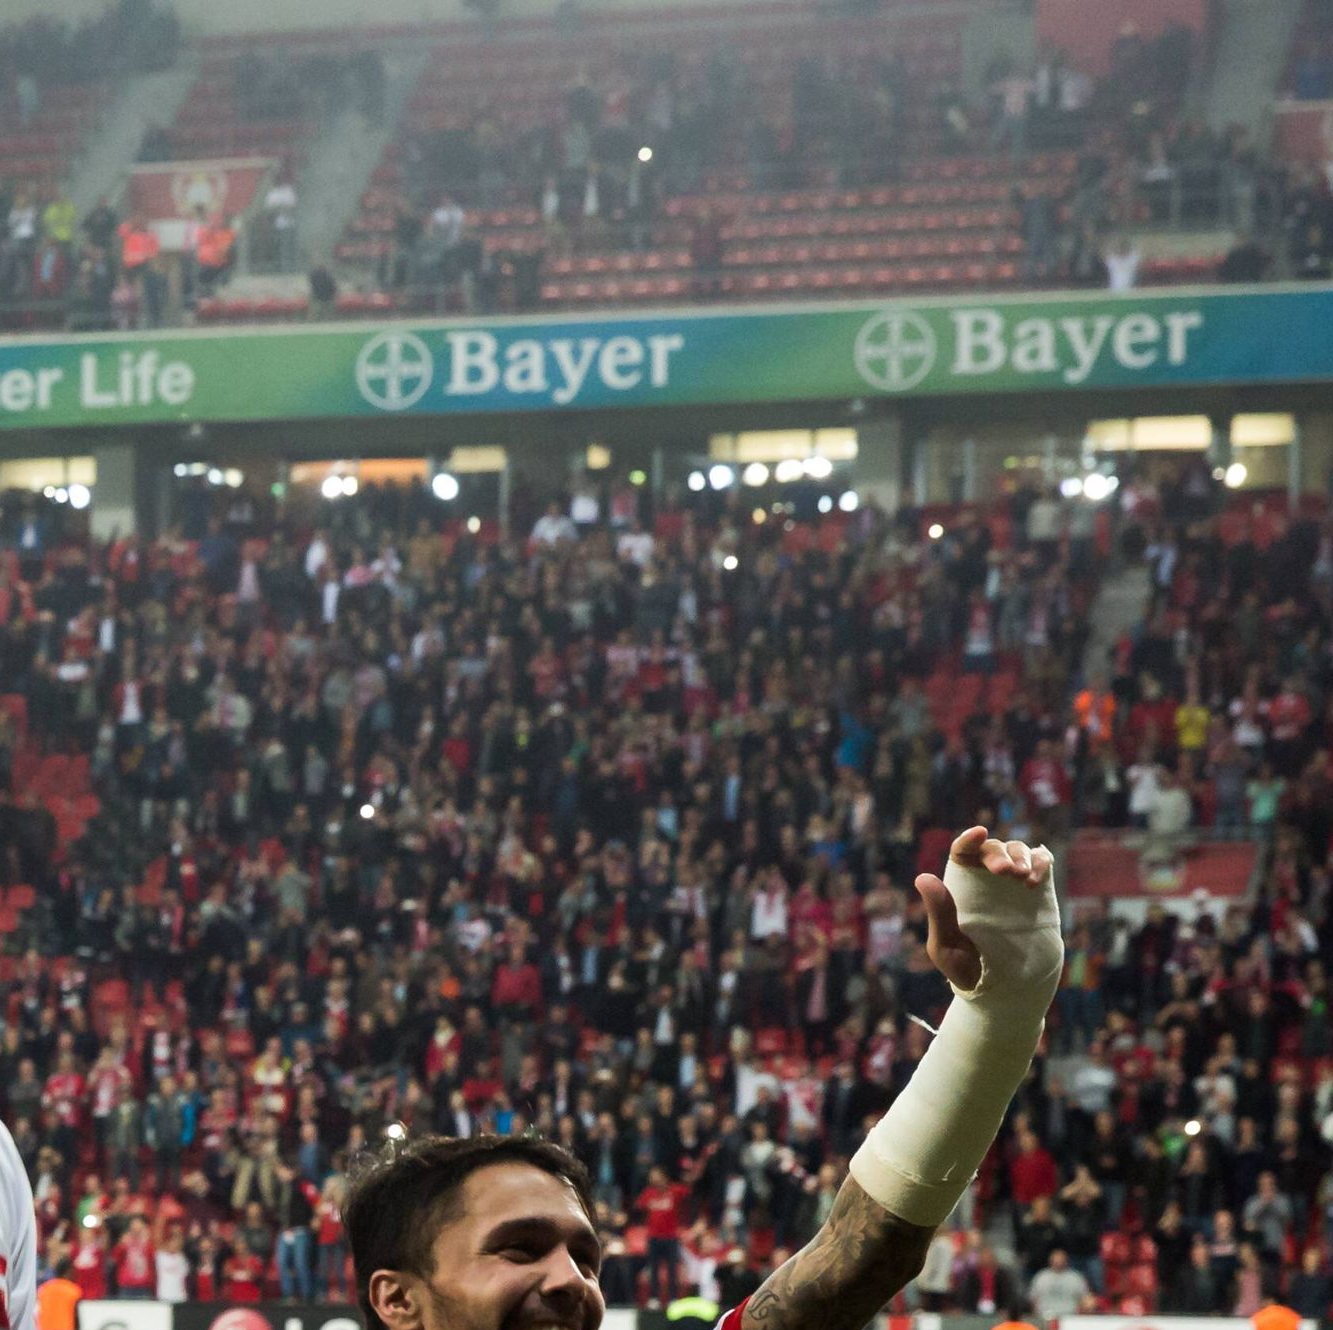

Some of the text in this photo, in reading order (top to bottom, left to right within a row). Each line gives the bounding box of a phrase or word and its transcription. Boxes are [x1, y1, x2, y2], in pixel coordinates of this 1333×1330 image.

[80, 349, 195, 408] Life
[445, 330, 684, 404] Bayer
[949, 308, 1203, 384] Bayer
